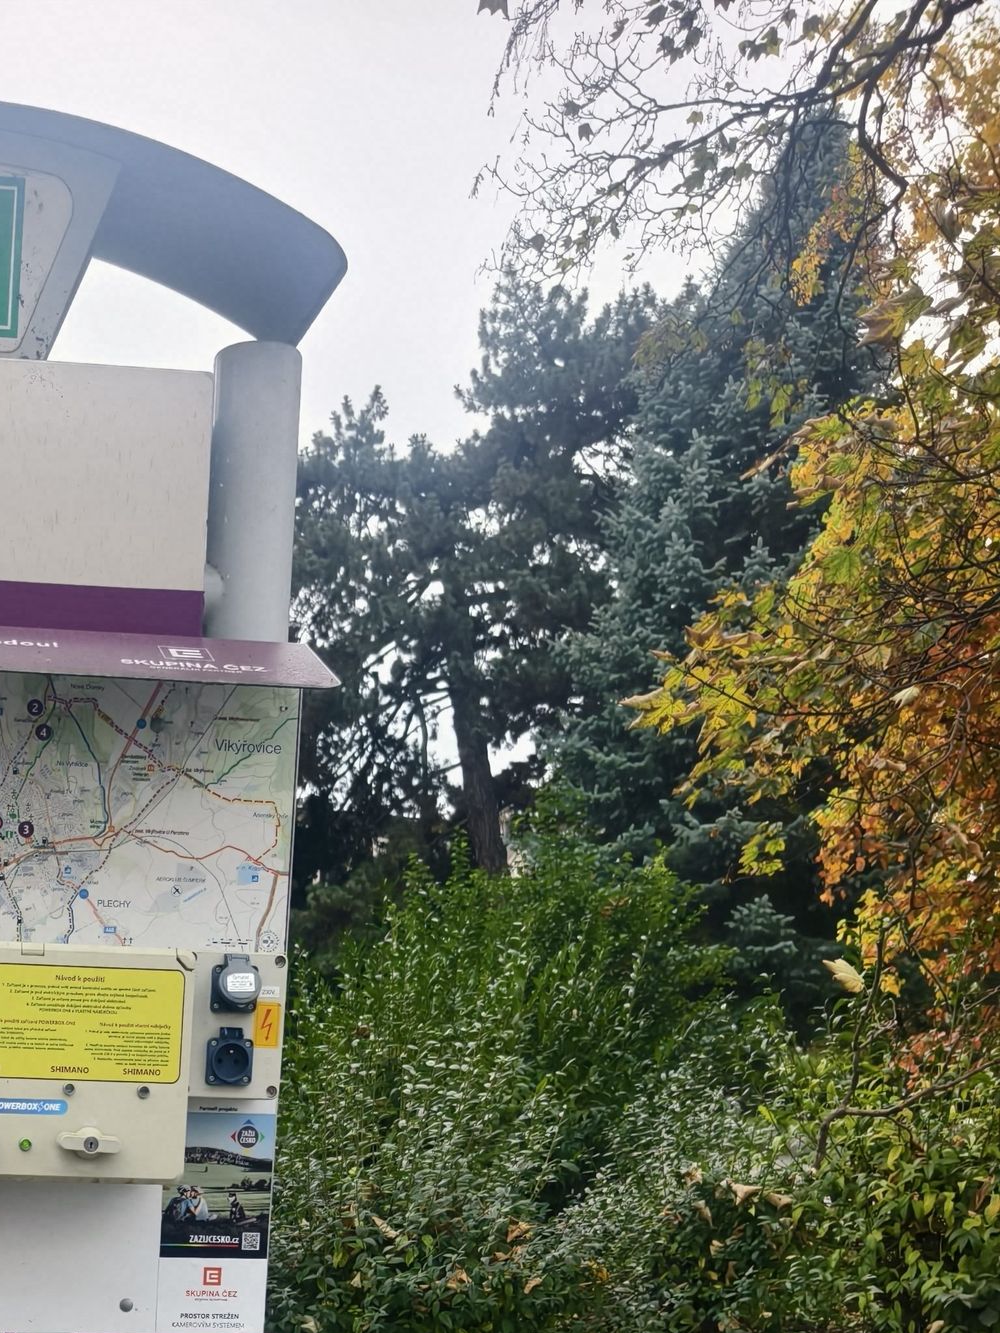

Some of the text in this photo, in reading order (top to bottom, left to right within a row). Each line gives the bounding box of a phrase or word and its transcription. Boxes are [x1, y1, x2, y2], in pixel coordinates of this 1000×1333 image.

[119, 659, 220, 670] SKUPINA
[215, 738, 282, 754] Vikýřovice
[55, 974, 75, 982] Návod
[82, 976, 105, 984] použití
[50, 1065, 89, 1074] SHIMANO
[122, 1068, 160, 1076] SHIMANO
[44, 1102, 61, 1111] ONE
